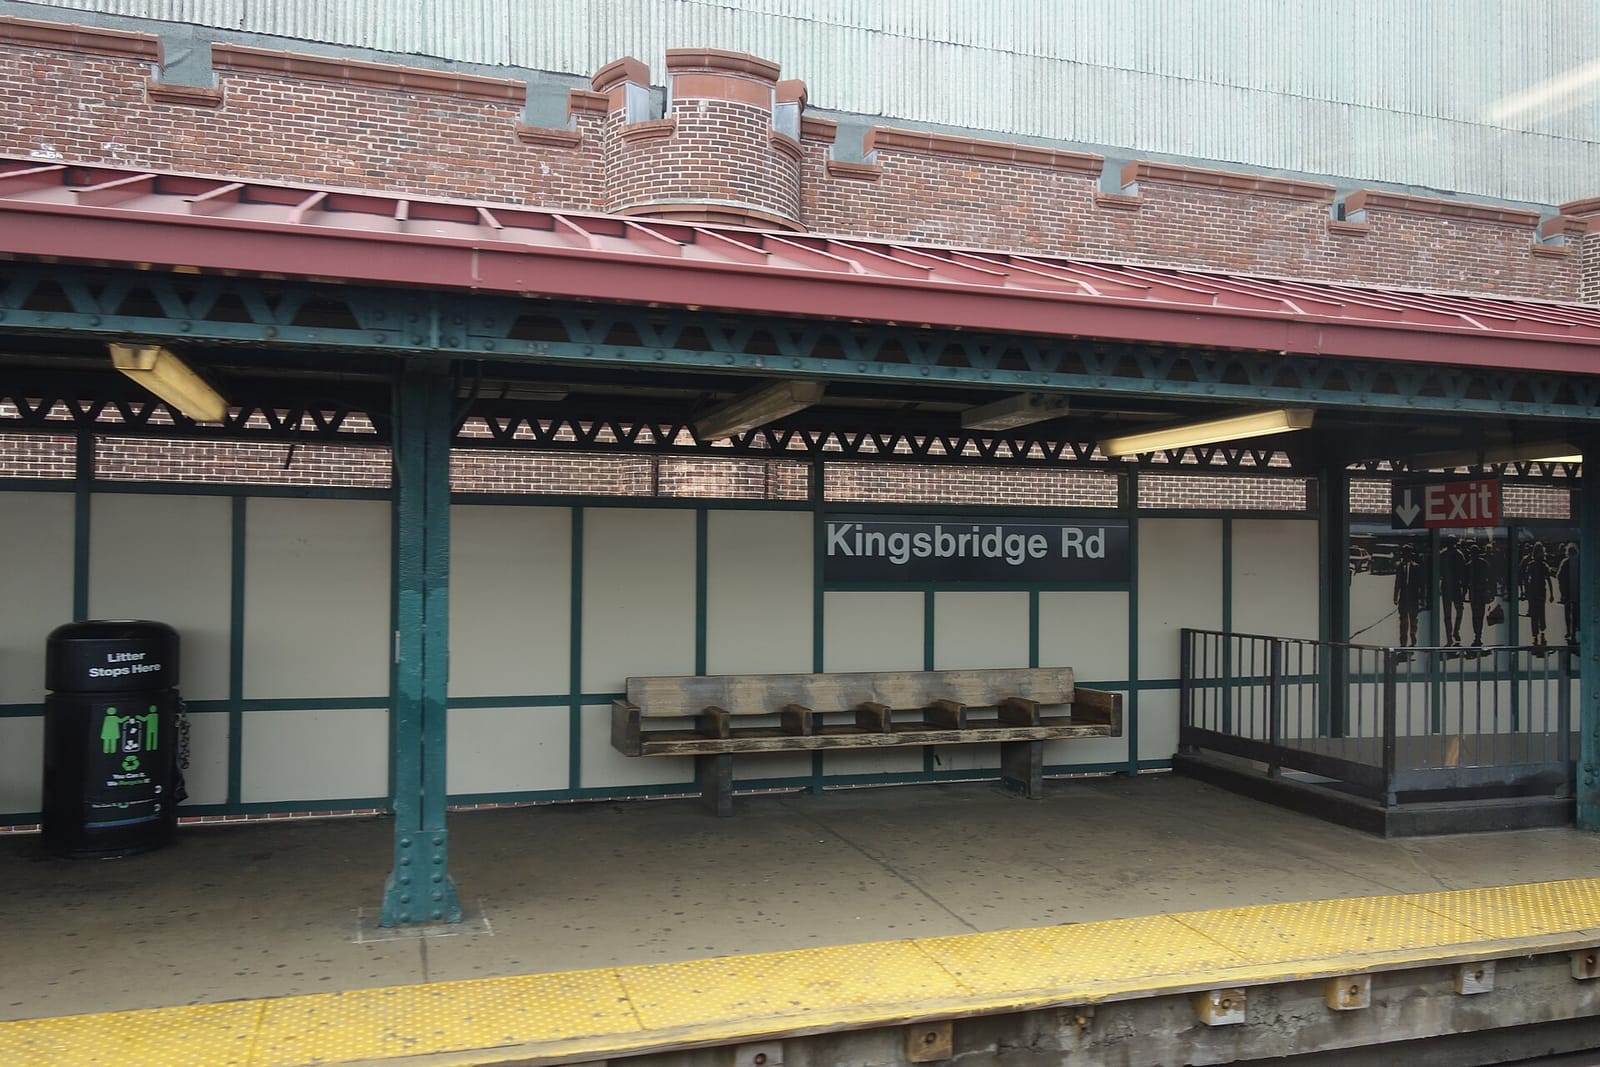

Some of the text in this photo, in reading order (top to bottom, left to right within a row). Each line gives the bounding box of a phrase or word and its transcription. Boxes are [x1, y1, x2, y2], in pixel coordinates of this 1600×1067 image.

[1424, 483, 1493, 521] Exit
[827, 523, 1105, 565] Kingsbridge Rd
[88, 663, 161, 677] Stops Here
[107, 652, 146, 663] Litter
